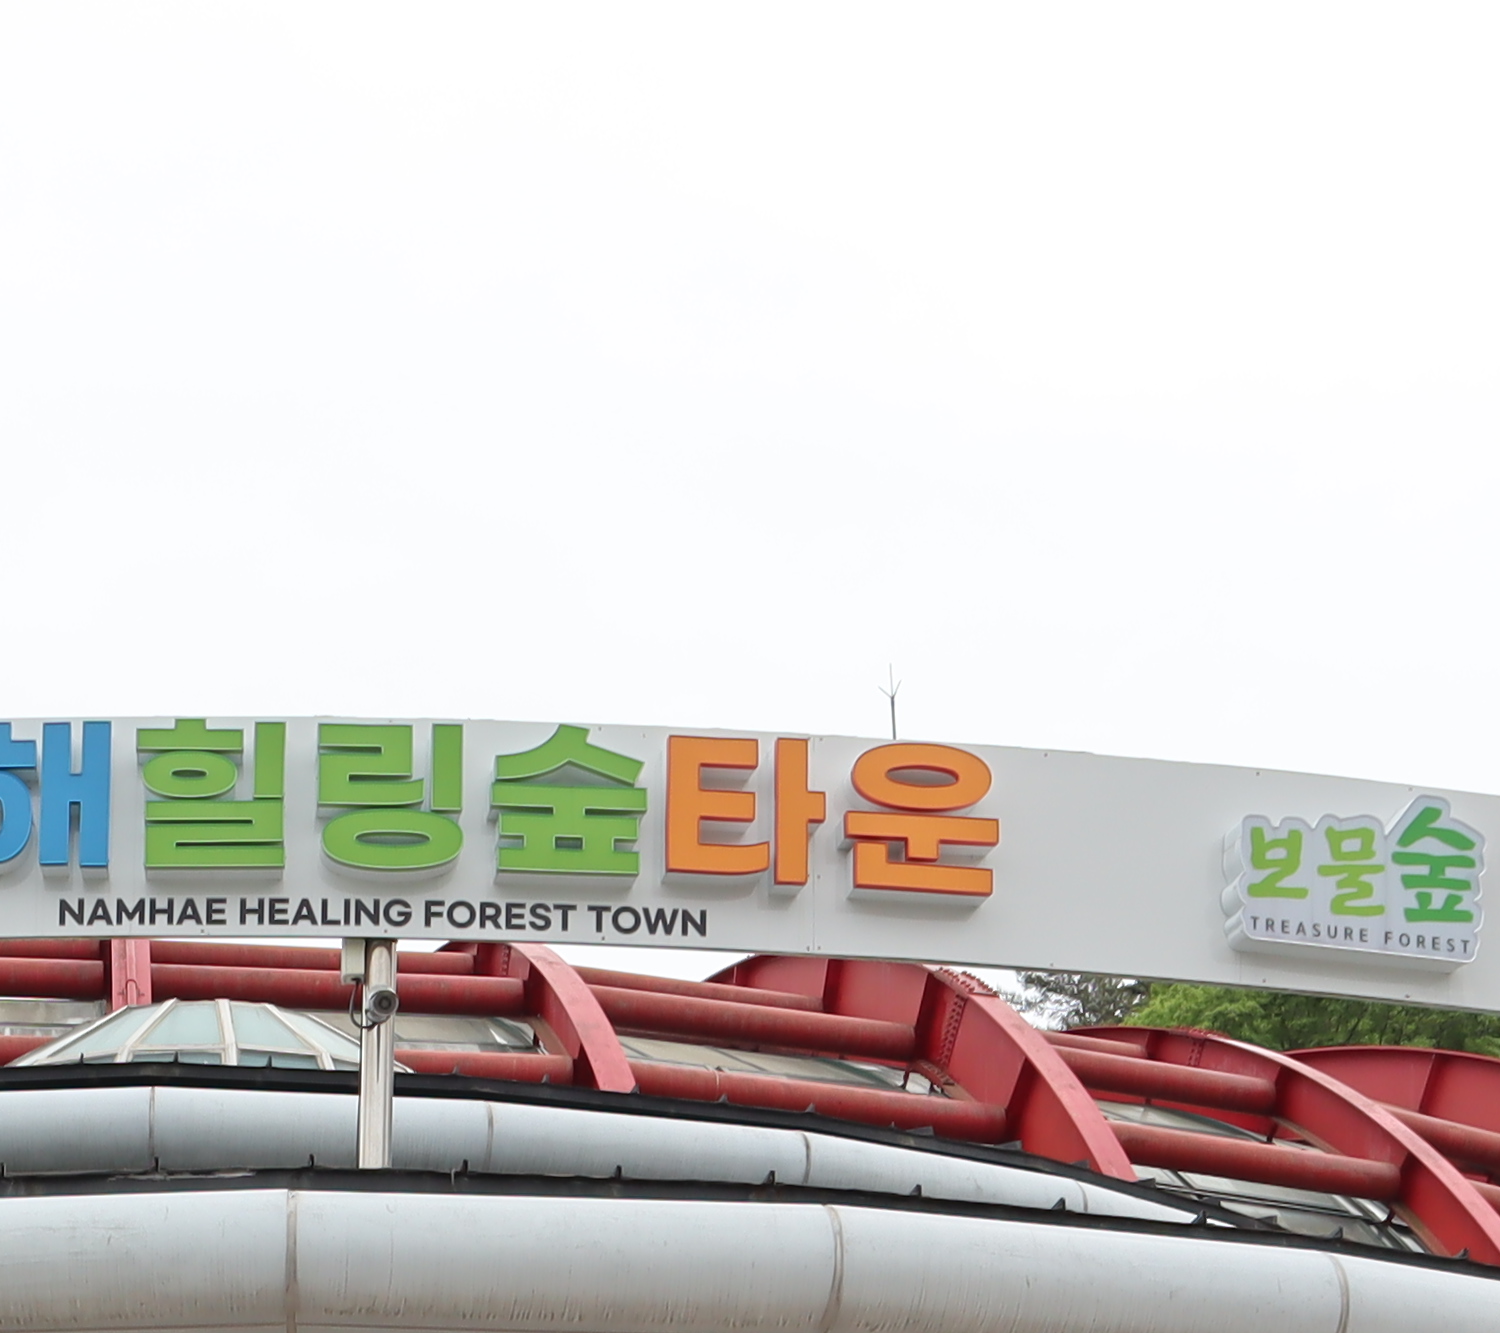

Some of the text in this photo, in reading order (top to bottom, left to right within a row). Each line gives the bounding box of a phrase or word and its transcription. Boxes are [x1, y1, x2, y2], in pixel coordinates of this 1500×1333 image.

[1247, 803, 1474, 926] 보물숲
[58, 897, 708, 940] NAMHAE HEALING FOREST TOWN
[1250, 916, 1472, 955] TREASURE FOREST
